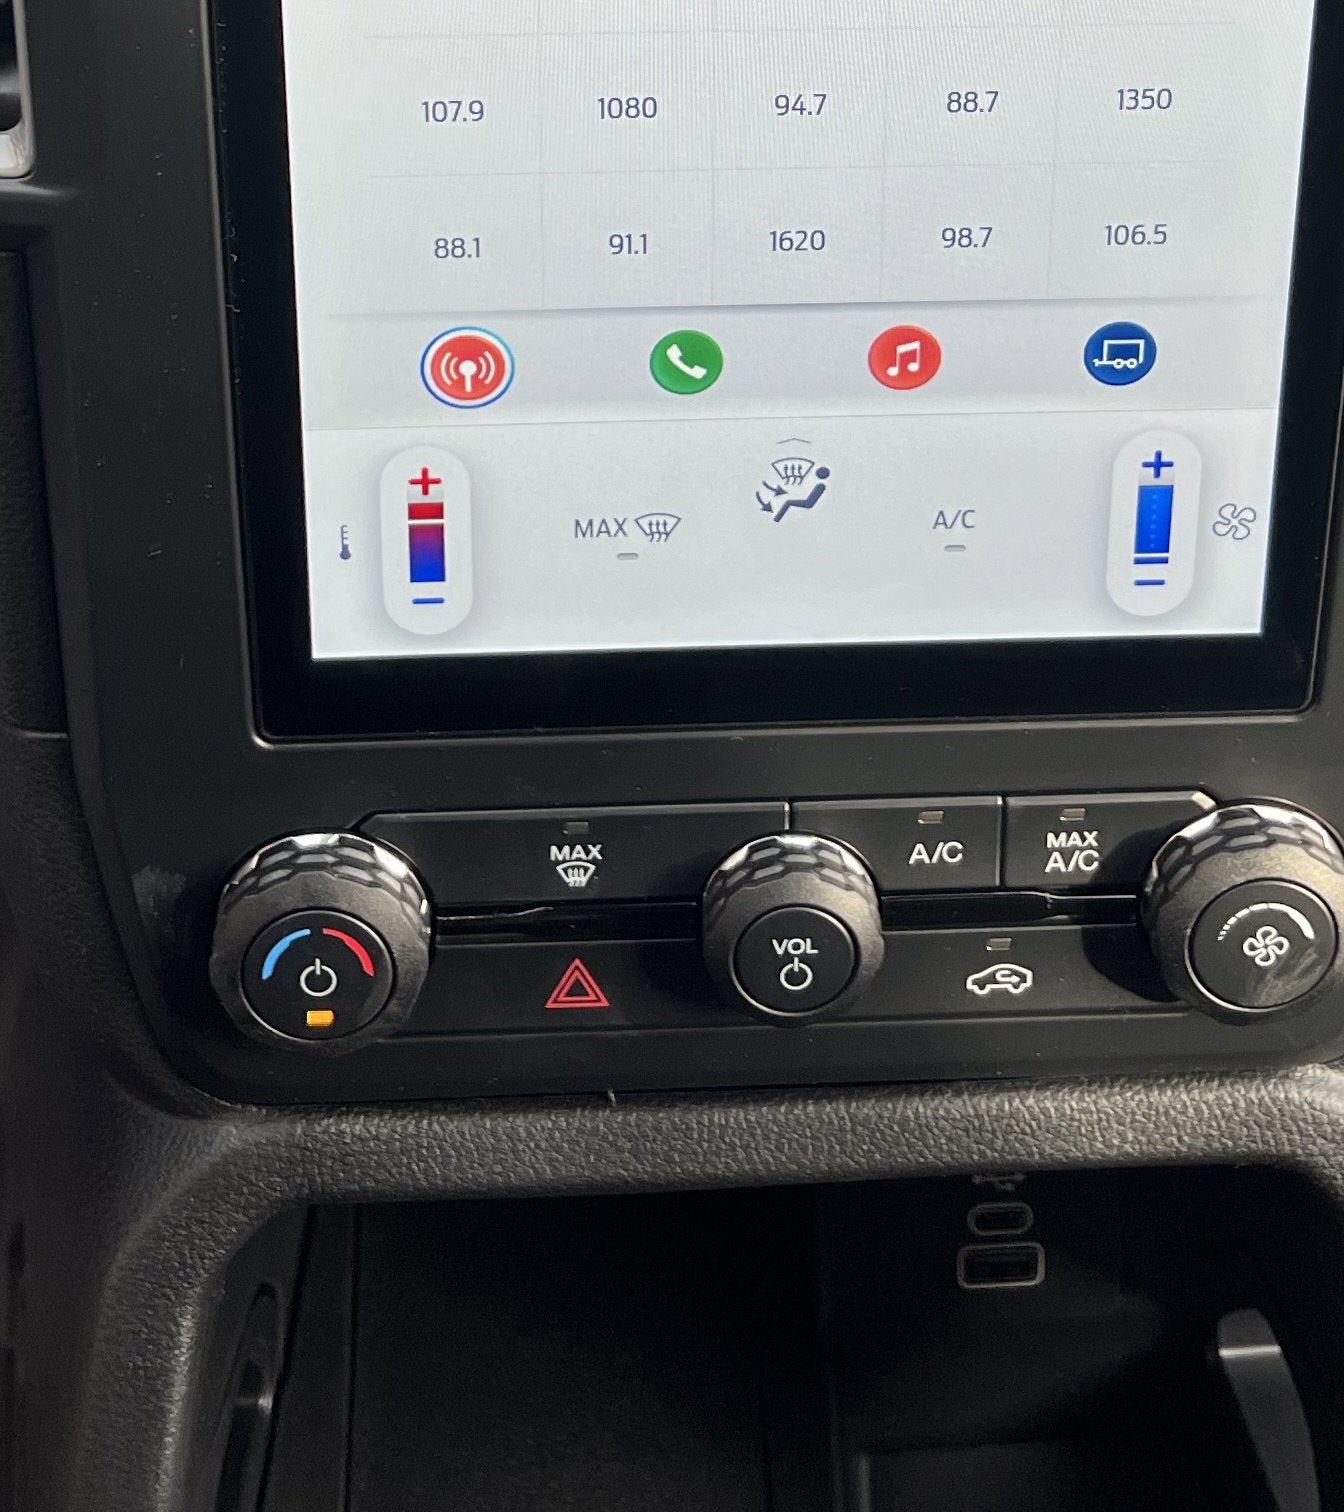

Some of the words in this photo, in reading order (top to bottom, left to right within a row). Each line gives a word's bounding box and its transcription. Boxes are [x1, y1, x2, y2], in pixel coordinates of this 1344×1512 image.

[597, 96, 658, 120] 1080
[774, 93, 827, 117] 94.7
[946, 90, 999, 114] 88.7
[1117, 87, 1173, 111] 1350
[421, 99, 485, 123] 107.9
[608, 233, 647, 255] 91.1
[769, 229, 826, 252] 1620
[941, 226, 993, 249] 98.7
[1105, 223, 1168, 246] 106.5
[434, 237, 481, 260] 88.1
[574, 517, 628, 539] MAX
[932, 509, 976, 530] A/C
[1046, 829, 1099, 850] MAX
[550, 843, 603, 863] MAX
[908, 841, 964, 865] A/C
[1044, 849, 1100, 874] A/C
[772, 936, 820, 957] VOL
